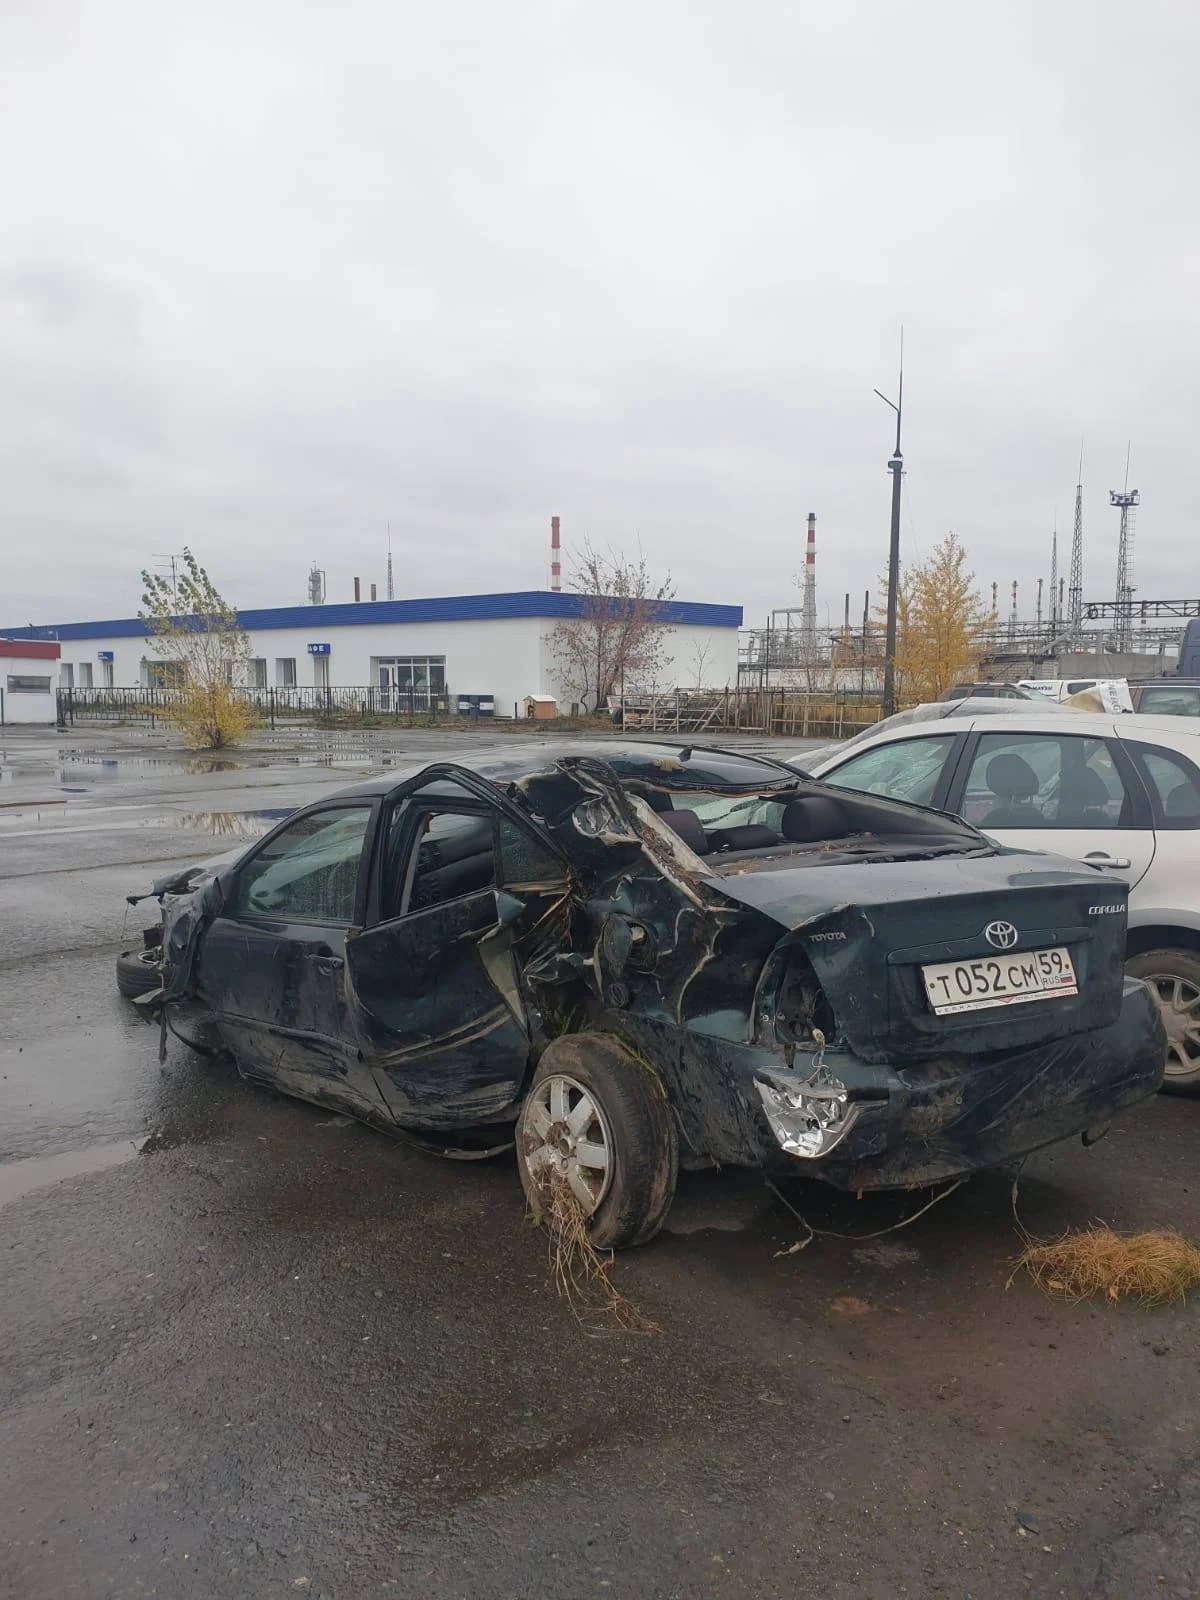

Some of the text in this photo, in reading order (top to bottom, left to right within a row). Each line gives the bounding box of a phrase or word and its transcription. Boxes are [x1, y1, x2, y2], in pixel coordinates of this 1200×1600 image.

[1088, 904, 1126, 915] COROLLA
[809, 932, 847, 942] TOYOTA
[1038, 952, 1062, 975] 59
[1041, 976, 1060, 985] RUS
